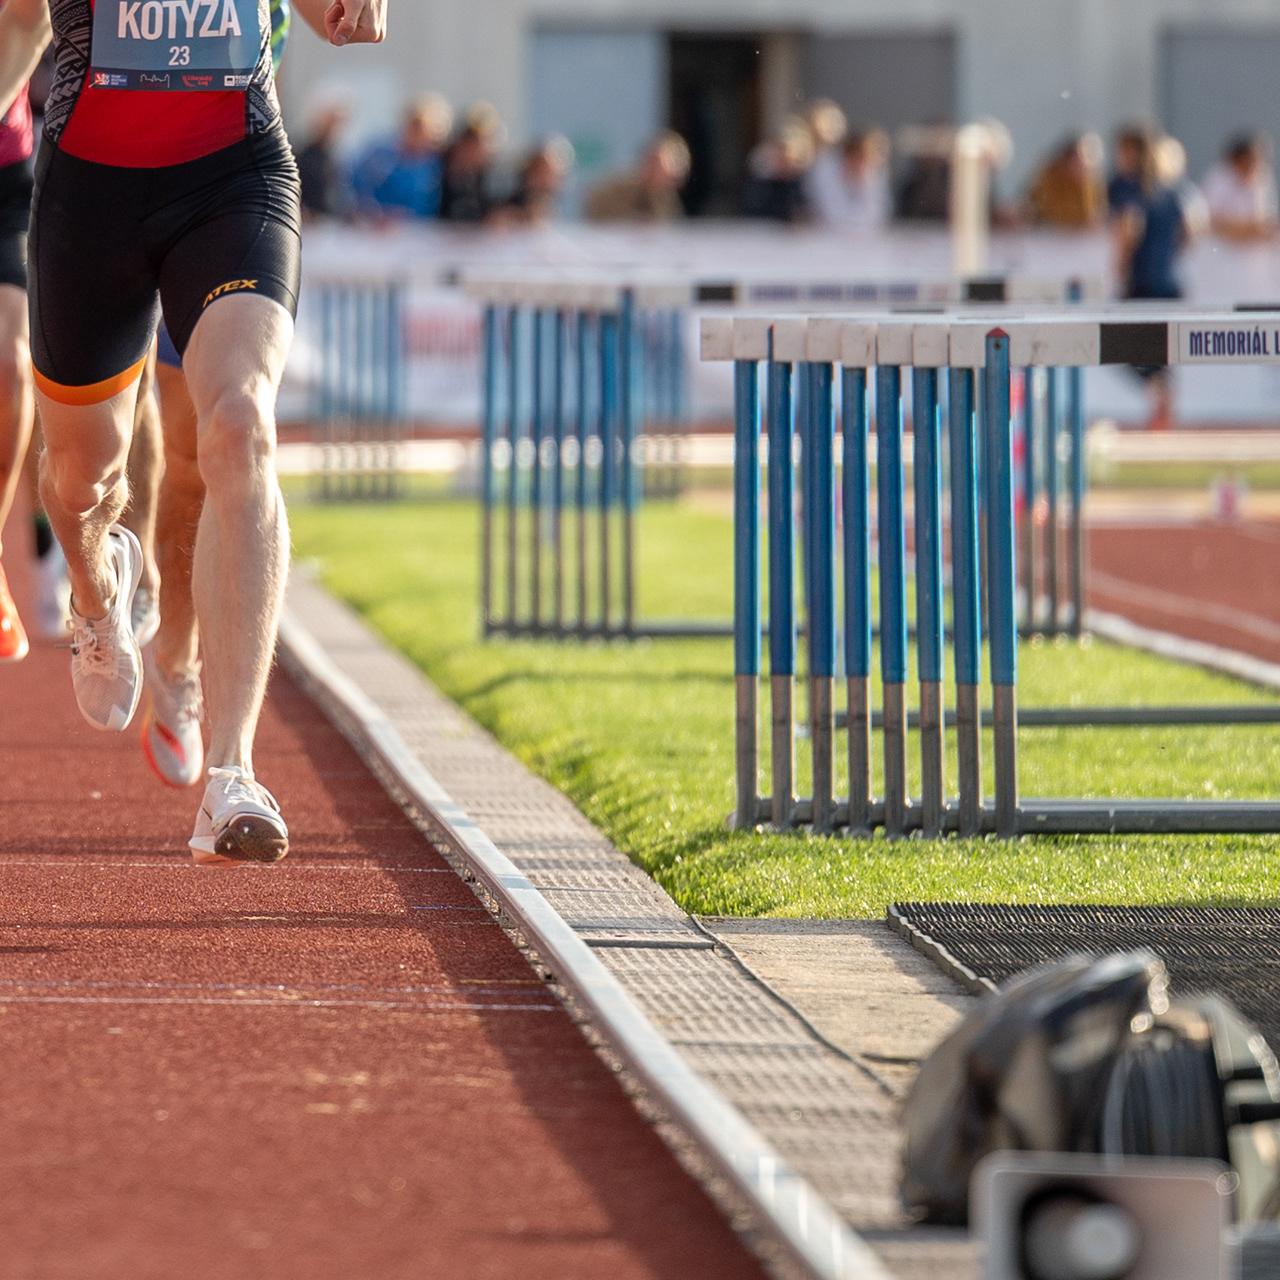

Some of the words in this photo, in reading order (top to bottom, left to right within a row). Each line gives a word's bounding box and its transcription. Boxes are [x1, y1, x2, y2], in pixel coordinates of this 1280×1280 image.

[168, 45, 190, 66] 23
[202, 279, 258, 308] ATEX
[1189, 326, 1270, 356] MEMORIÁL
